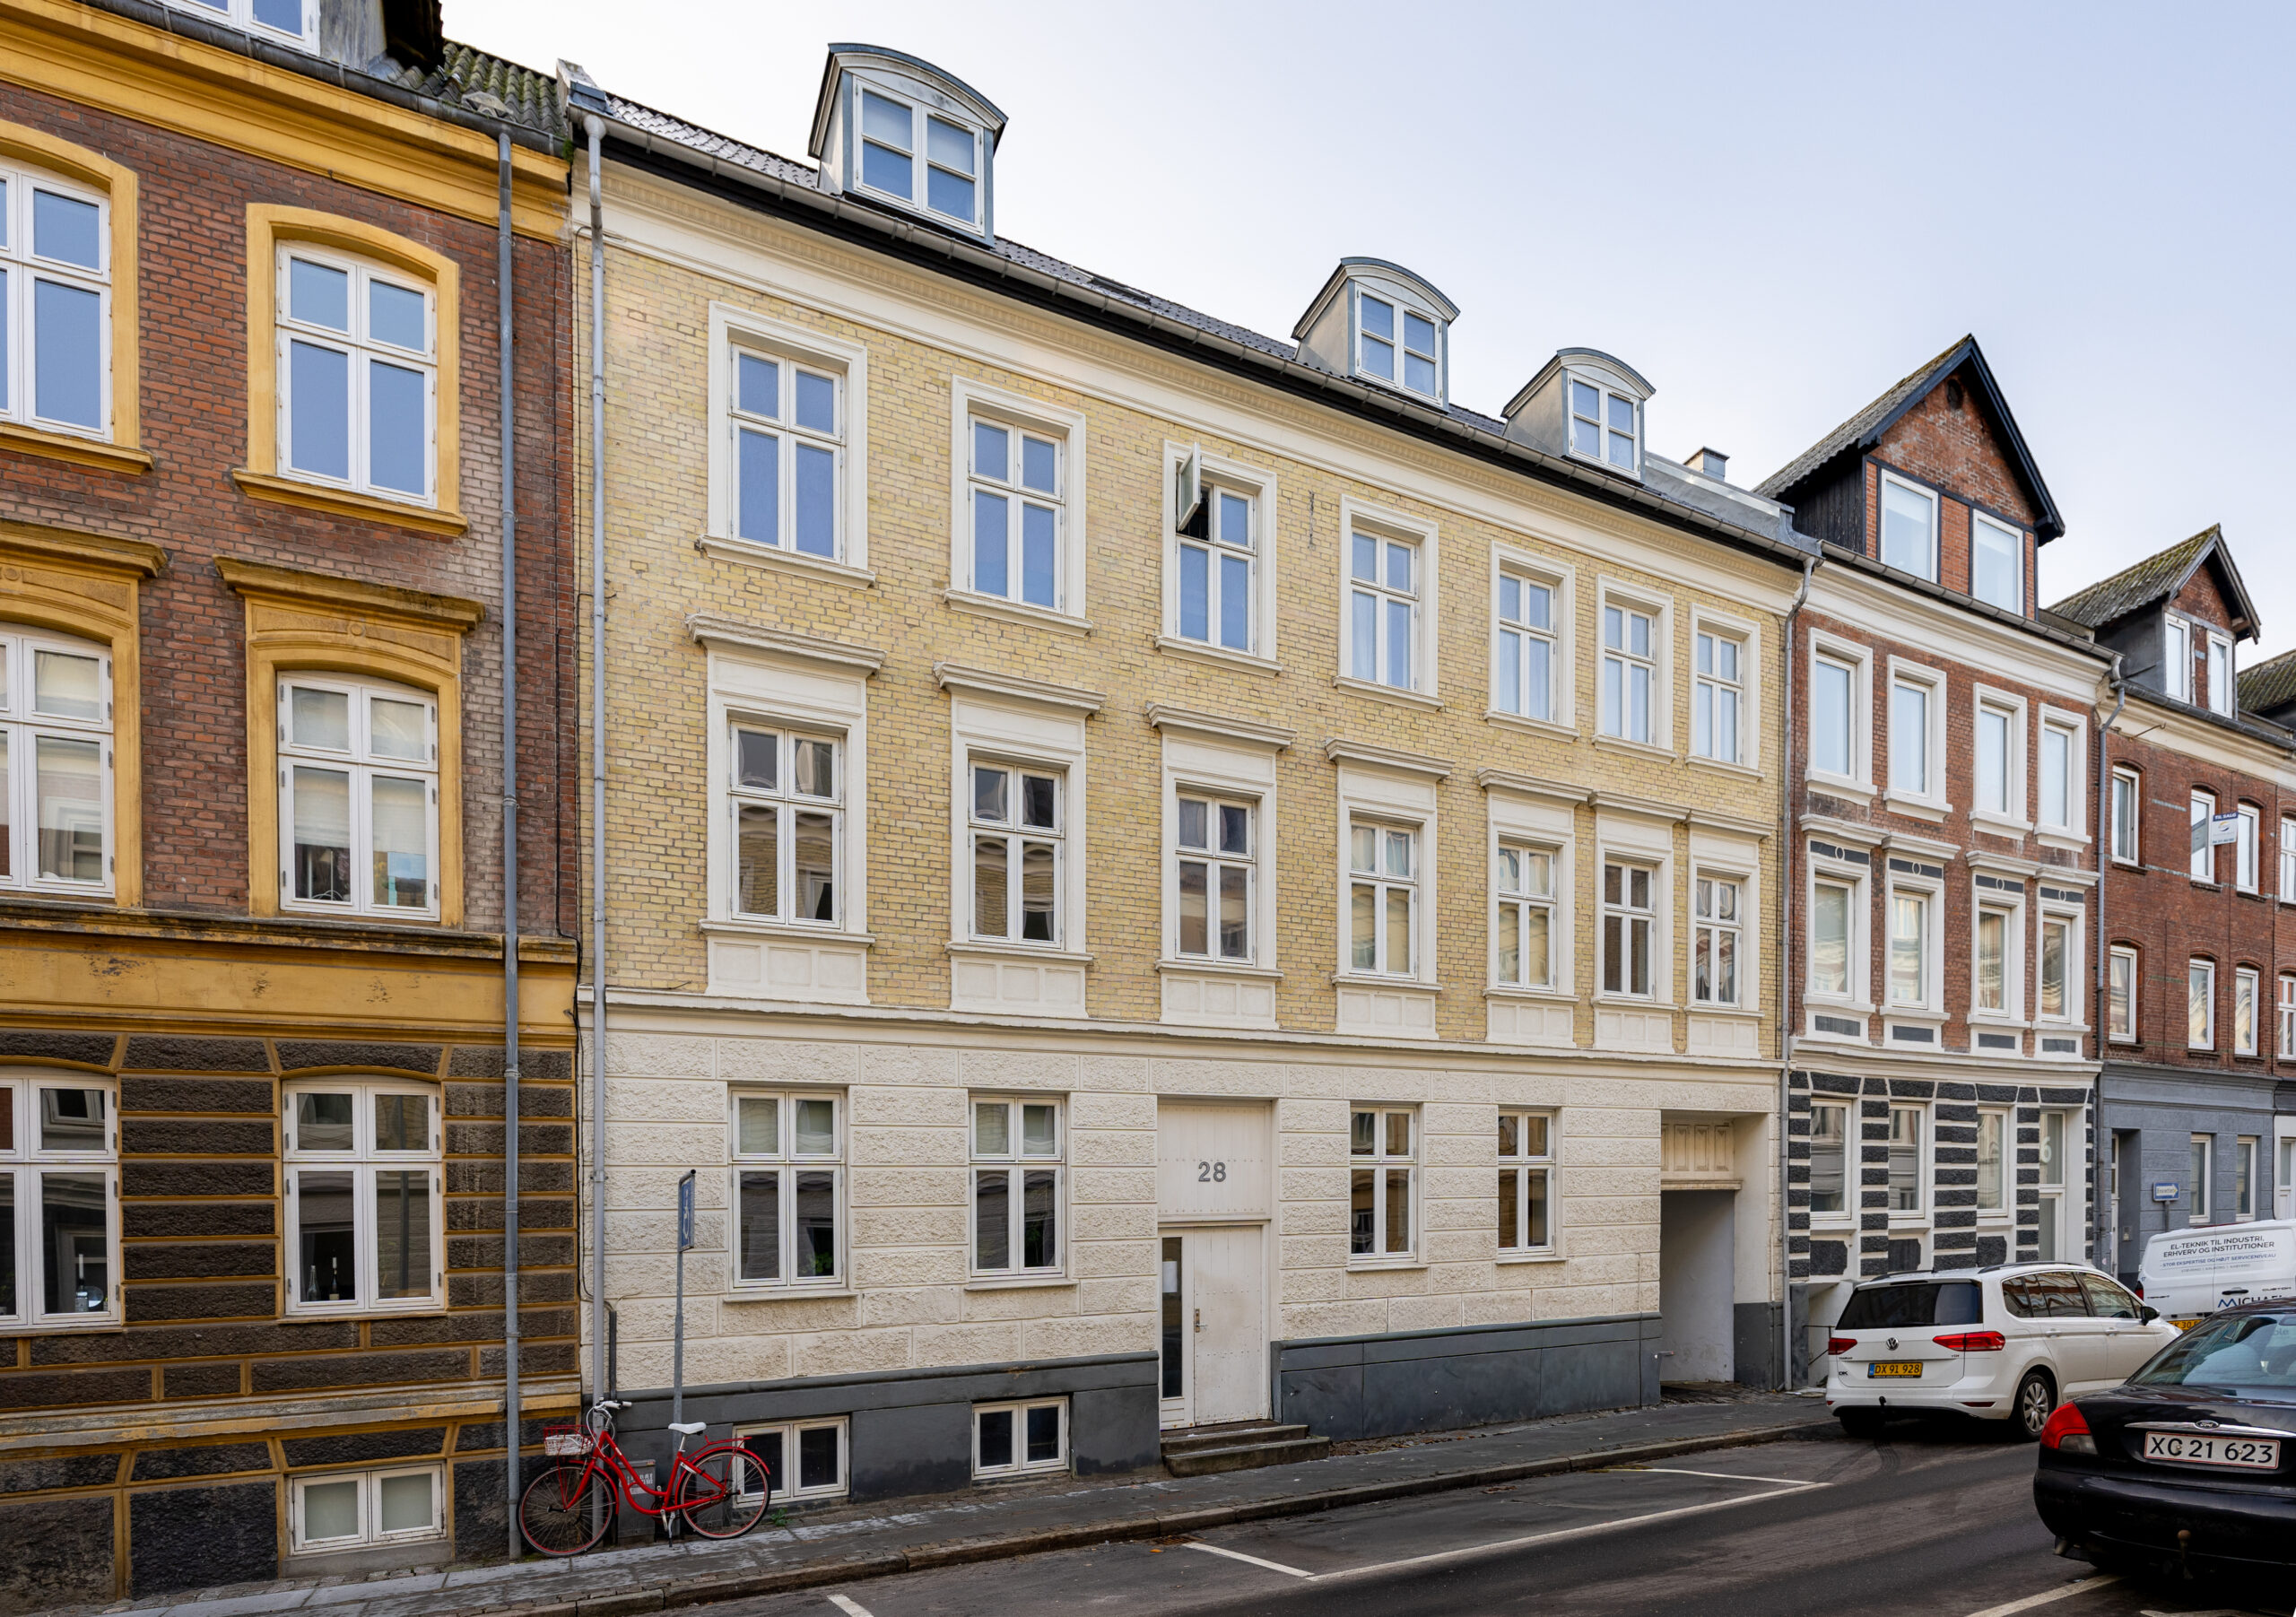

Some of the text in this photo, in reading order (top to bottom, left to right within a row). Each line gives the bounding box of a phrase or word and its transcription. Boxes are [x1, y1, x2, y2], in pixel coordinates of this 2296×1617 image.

[1198, 1161, 1227, 1183] 28
[2163, 1248, 2197, 1257] ERHVERV
[2212, 1241, 2275, 1253] INSTITUTIONER
[2170, 1240, 2209, 1250] EL-TEKNIK
[2231, 1253, 2277, 1261] SERVICENIVEAU
[1875, 1364, 1920, 1374] DX 91 928
[2188, 1439, 2213, 1459] 21
[2224, 1442, 2273, 1464] 623
